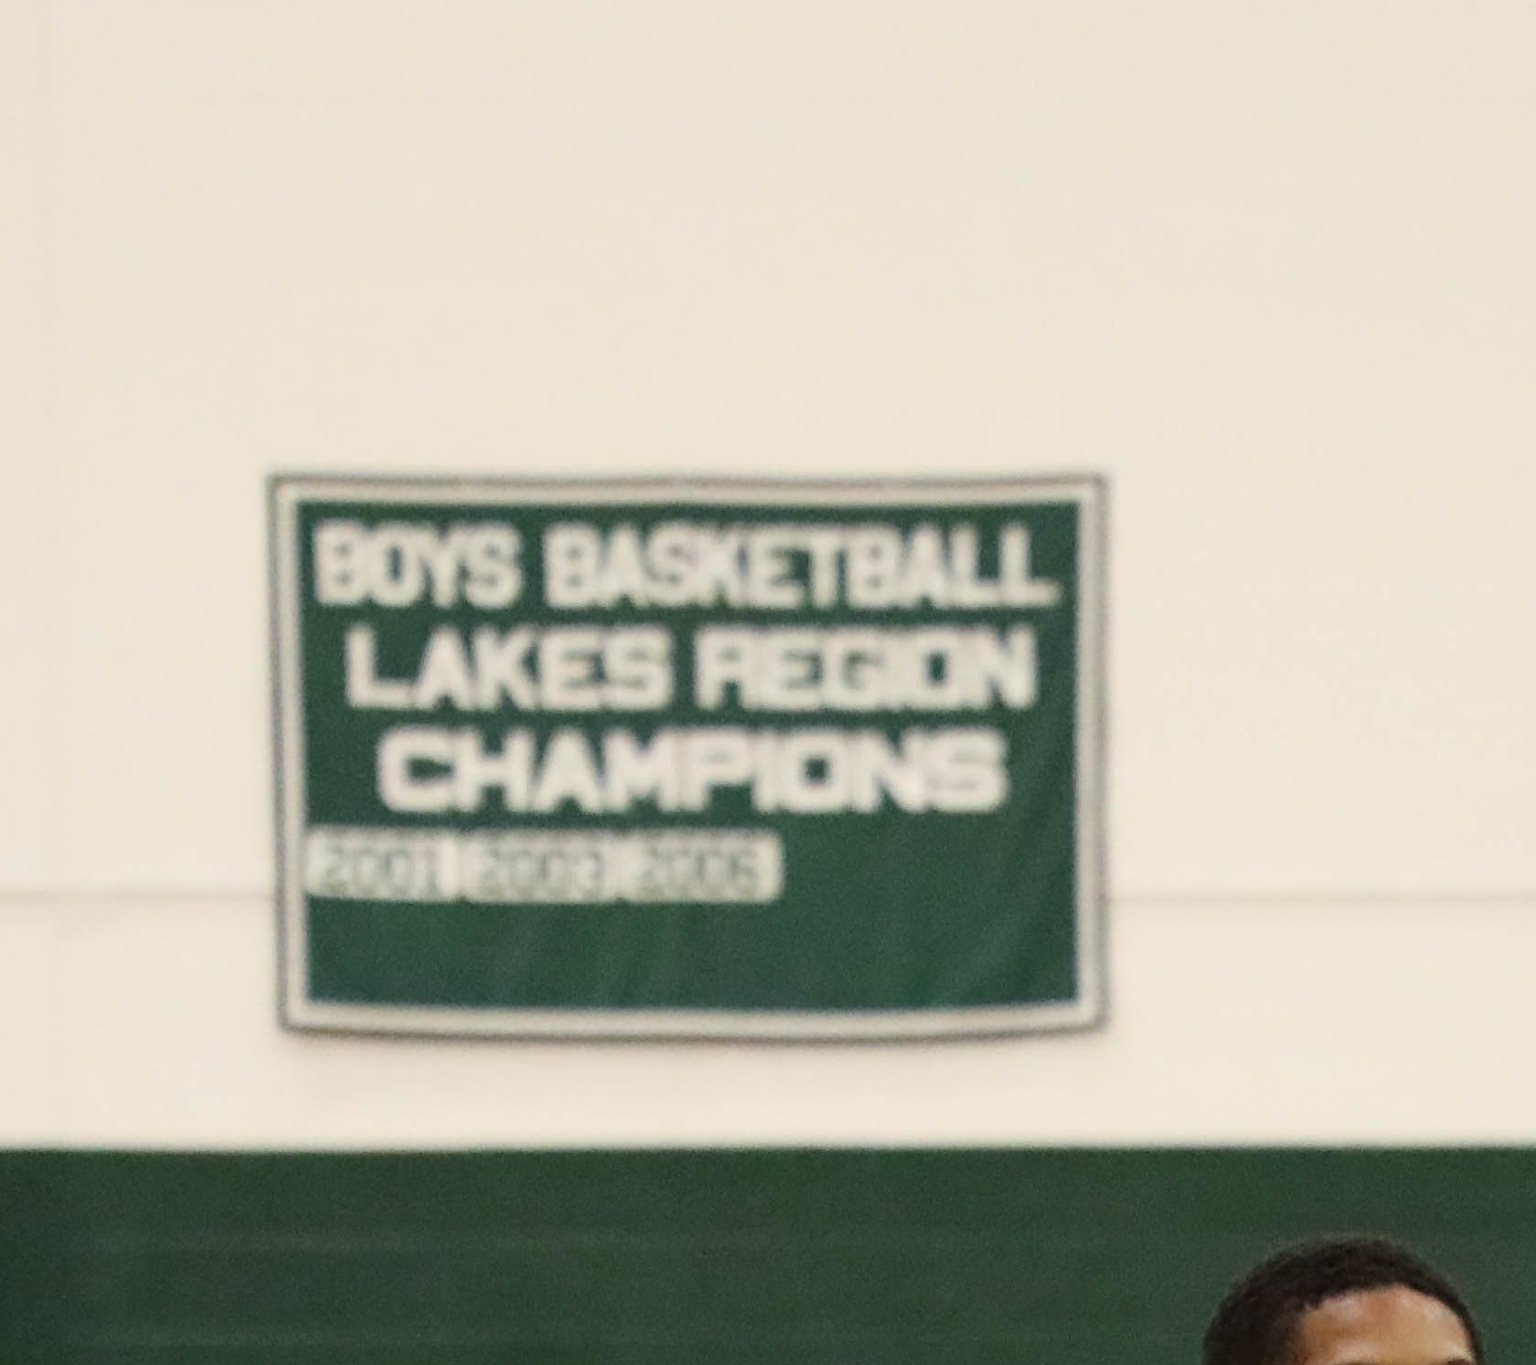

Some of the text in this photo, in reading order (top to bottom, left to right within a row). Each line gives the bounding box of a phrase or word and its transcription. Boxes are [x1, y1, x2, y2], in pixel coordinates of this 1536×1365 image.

[313, 520, 1060, 611] BOYS BASKETBALL
[346, 623, 1038, 711] LAKES REGION
[376, 725, 1009, 814] CHAMPIONS
